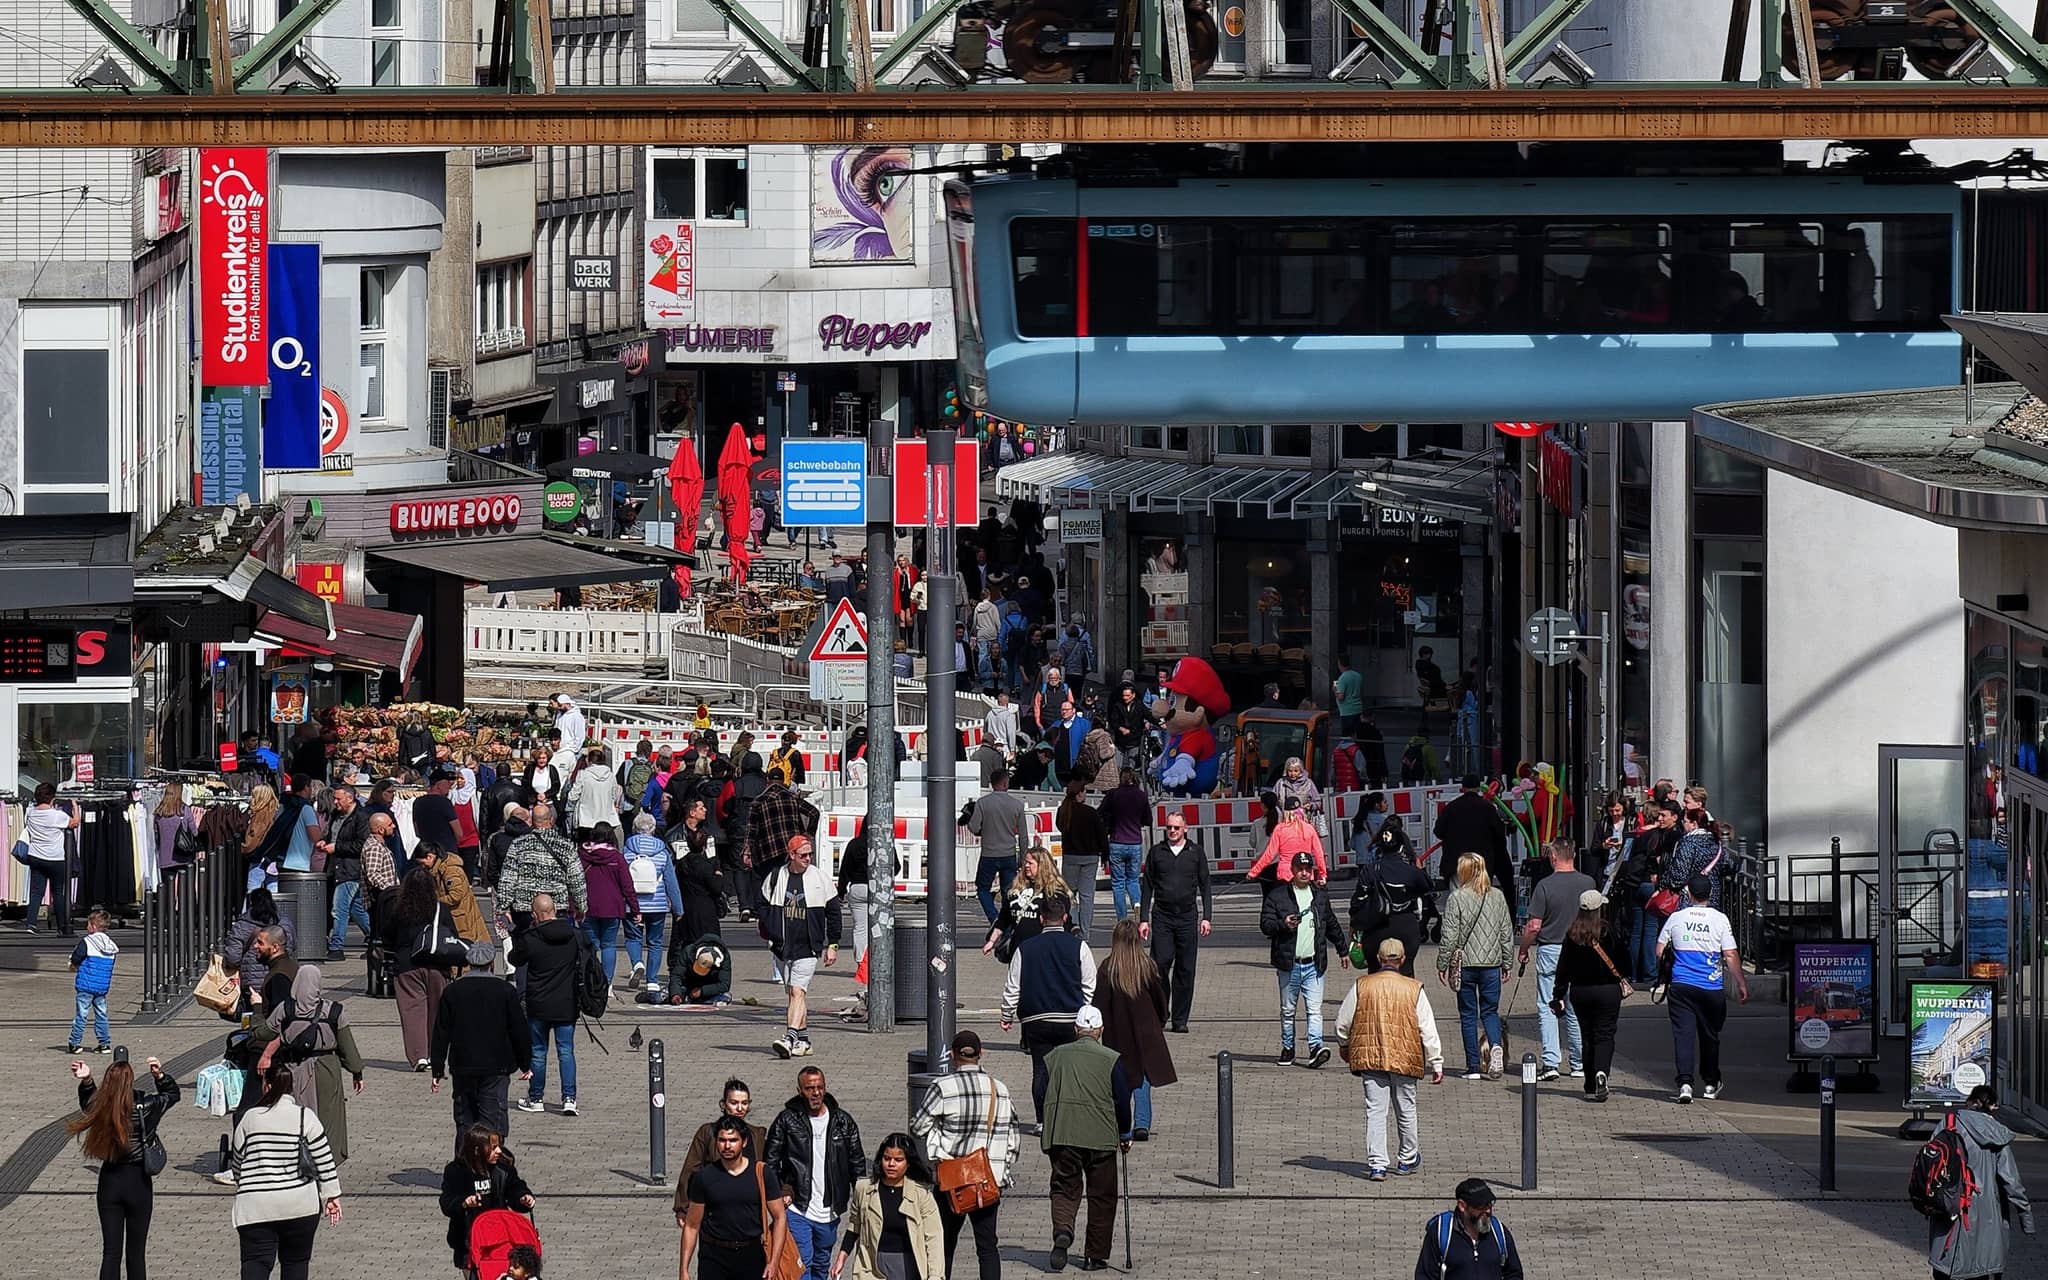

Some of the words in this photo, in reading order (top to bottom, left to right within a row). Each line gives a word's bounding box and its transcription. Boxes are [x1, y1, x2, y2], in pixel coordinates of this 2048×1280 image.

[249, 210, 261, 234] alle!
[249, 236, 261, 253] für
[576, 262, 610, 275] back
[221, 194, 248, 363] Studienkreis
[574, 277, 611, 289] WERK
[249, 257, 261, 342] Profi-Nachhilfe
[657, 323, 775, 351] RFÜMERIE
[819, 314, 932, 356] Pieper
[787, 460, 861, 470] schwebebahn
[590, 470, 612, 479] WERK
[547, 493, 576, 501] BLUME
[396, 503, 460, 530] BLUME
[463, 496, 521, 526] 2000
[1063, 520, 1101, 528] POMMES
[1063, 528, 1101, 536] FREUNDE
[1342, 527, 1371, 536] BURGER
[1685, 921, 1711, 933] VISA
[1800, 957, 1867, 967] WUPPERTAL
[1916, 998, 1987, 1009] WUPPERTAL
[1916, 1010, 1987, 1019] STADTFÜHRUNGEN
